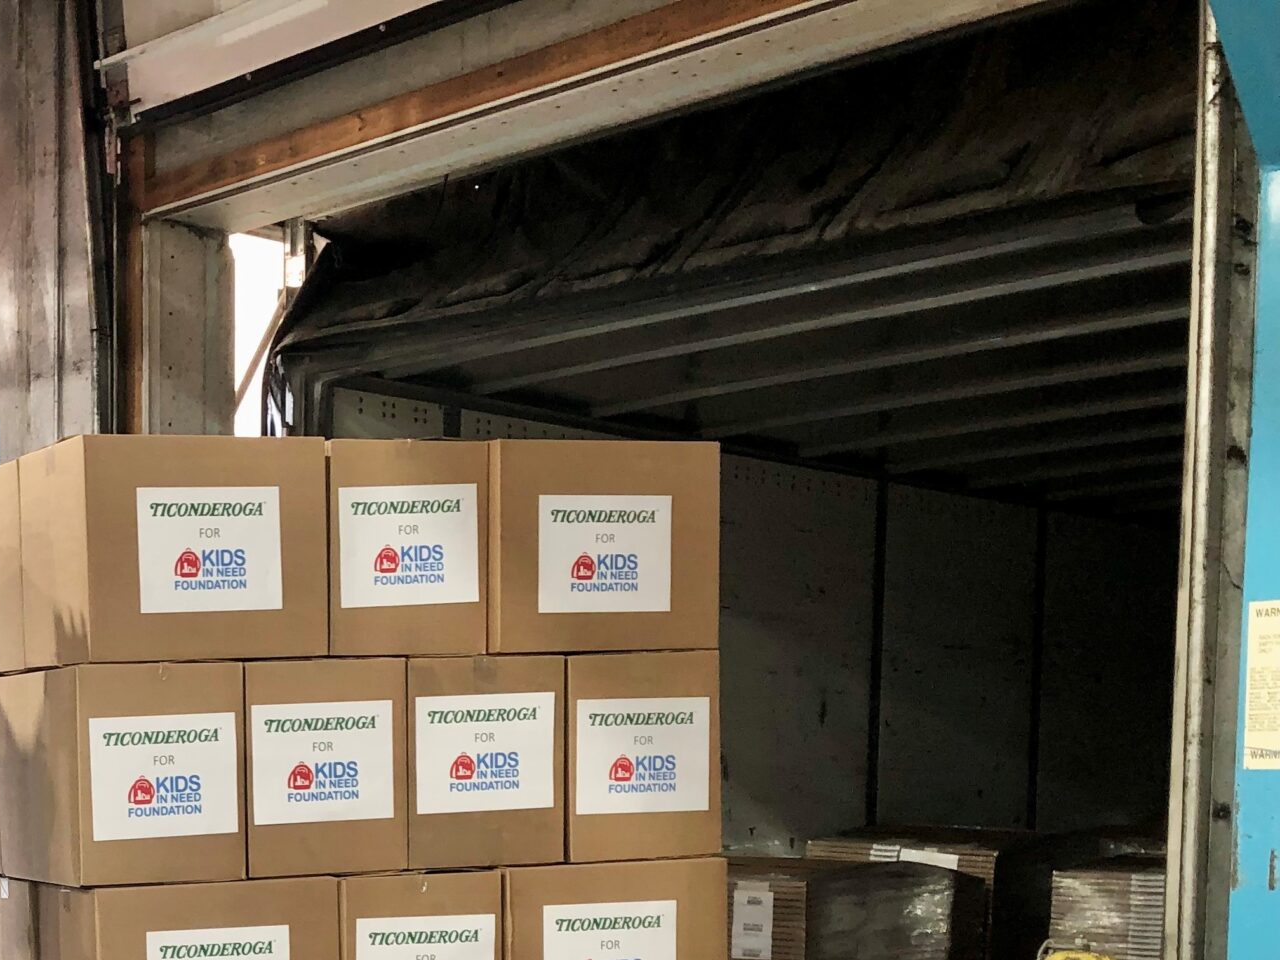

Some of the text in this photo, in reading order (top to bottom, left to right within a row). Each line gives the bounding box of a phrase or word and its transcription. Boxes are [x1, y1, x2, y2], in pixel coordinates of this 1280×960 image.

[150, 502, 263, 518] TICONDEROGA
[350, 498, 461, 516] TICONDEROGA
[550, 509, 656, 524] TICONDEROGA
[199, 528, 221, 538] FOR
[398, 524, 419, 535] FOR
[595, 534, 615, 543] FOR
[202, 549, 246, 567] KIDS
[401, 544, 444, 562] KIDS
[401, 562, 444, 573] IN NEED
[597, 554, 638, 570] KIDS
[202, 567, 246, 578] IN NEED
[597, 571, 638, 580] IN NEED
[174, 579, 247, 591] FOUNDATION
[374, 573, 444, 586] FOUNDATION
[571, 582, 638, 592] FOUNDATION
[427, 707, 537, 725] TICONDEROGA
[589, 711, 694, 727] TICONDEROGA
[264, 715, 376, 734] TICONDEROGA
[102, 728, 219, 748] TICONDEROGA
[474, 732, 495, 743] FOR
[633, 735, 654, 746] FOR
[312, 741, 334, 752] FOR
[153, 755, 175, 766] FOR
[477, 751, 519, 769] KIDS
[635, 755, 676, 772] KIDS
[315, 761, 359, 779] KIDS
[477, 769, 519, 779] IN NEED
[635, 772, 676, 781] IN NEED
[156, 775, 201, 794] KIDS
[315, 778, 359, 789] IN NEED
[450, 780, 519, 792] FOUNDATION
[609, 782, 676, 793] FOUNDATION
[156, 793, 201, 804] IN NEED
[287, 790, 359, 802] FOUNDATION
[128, 804, 202, 818] FOUNDATION
[555, 915, 661, 933] TICONDEROGA
[368, 929, 479, 946] TICONDEROGA
[159, 940, 273, 960] TICONDEROGA
[600, 940, 620, 950] FOR
